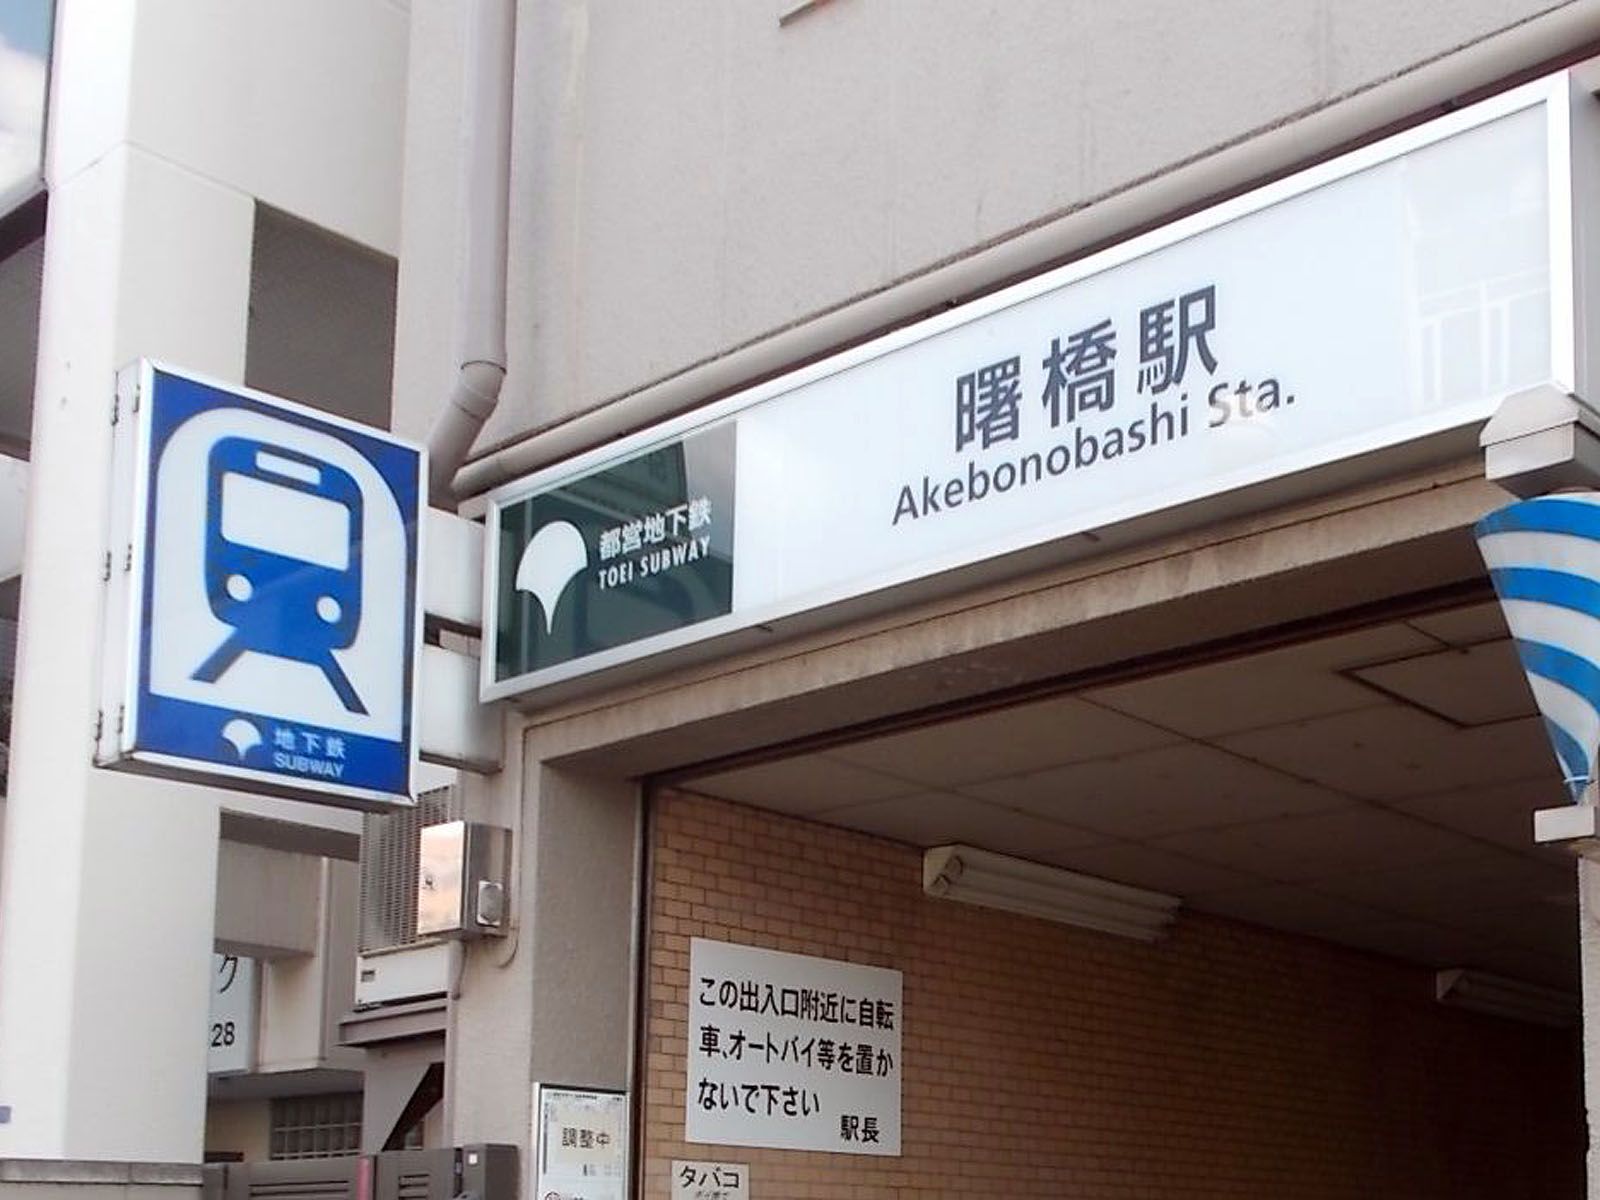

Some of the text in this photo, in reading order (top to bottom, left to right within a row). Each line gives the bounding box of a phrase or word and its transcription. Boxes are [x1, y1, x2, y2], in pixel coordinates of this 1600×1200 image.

[954, 283, 1218, 453] 曙橋駅
[892, 376, 1296, 526] Akebonobashi Sta.
[599, 496, 711, 561] 都営地下鉄
[598, 535, 711, 590] TOEI SUBWAY
[274, 726, 346, 760] 地下鉄
[273, 751, 345, 778] SUBWAY
[699, 977, 895, 1030] この出入口附近に自転
[210, 1020, 236, 1047] 28
[699, 1024, 895, 1077] 車、オートバイ等を置か
[698, 1077, 821, 1117] ないで下さい
[561, 1126, 612, 1149] 調整中
[840, 1114, 880, 1144] 駅長
[679, 1165, 740, 1189] タバコ
